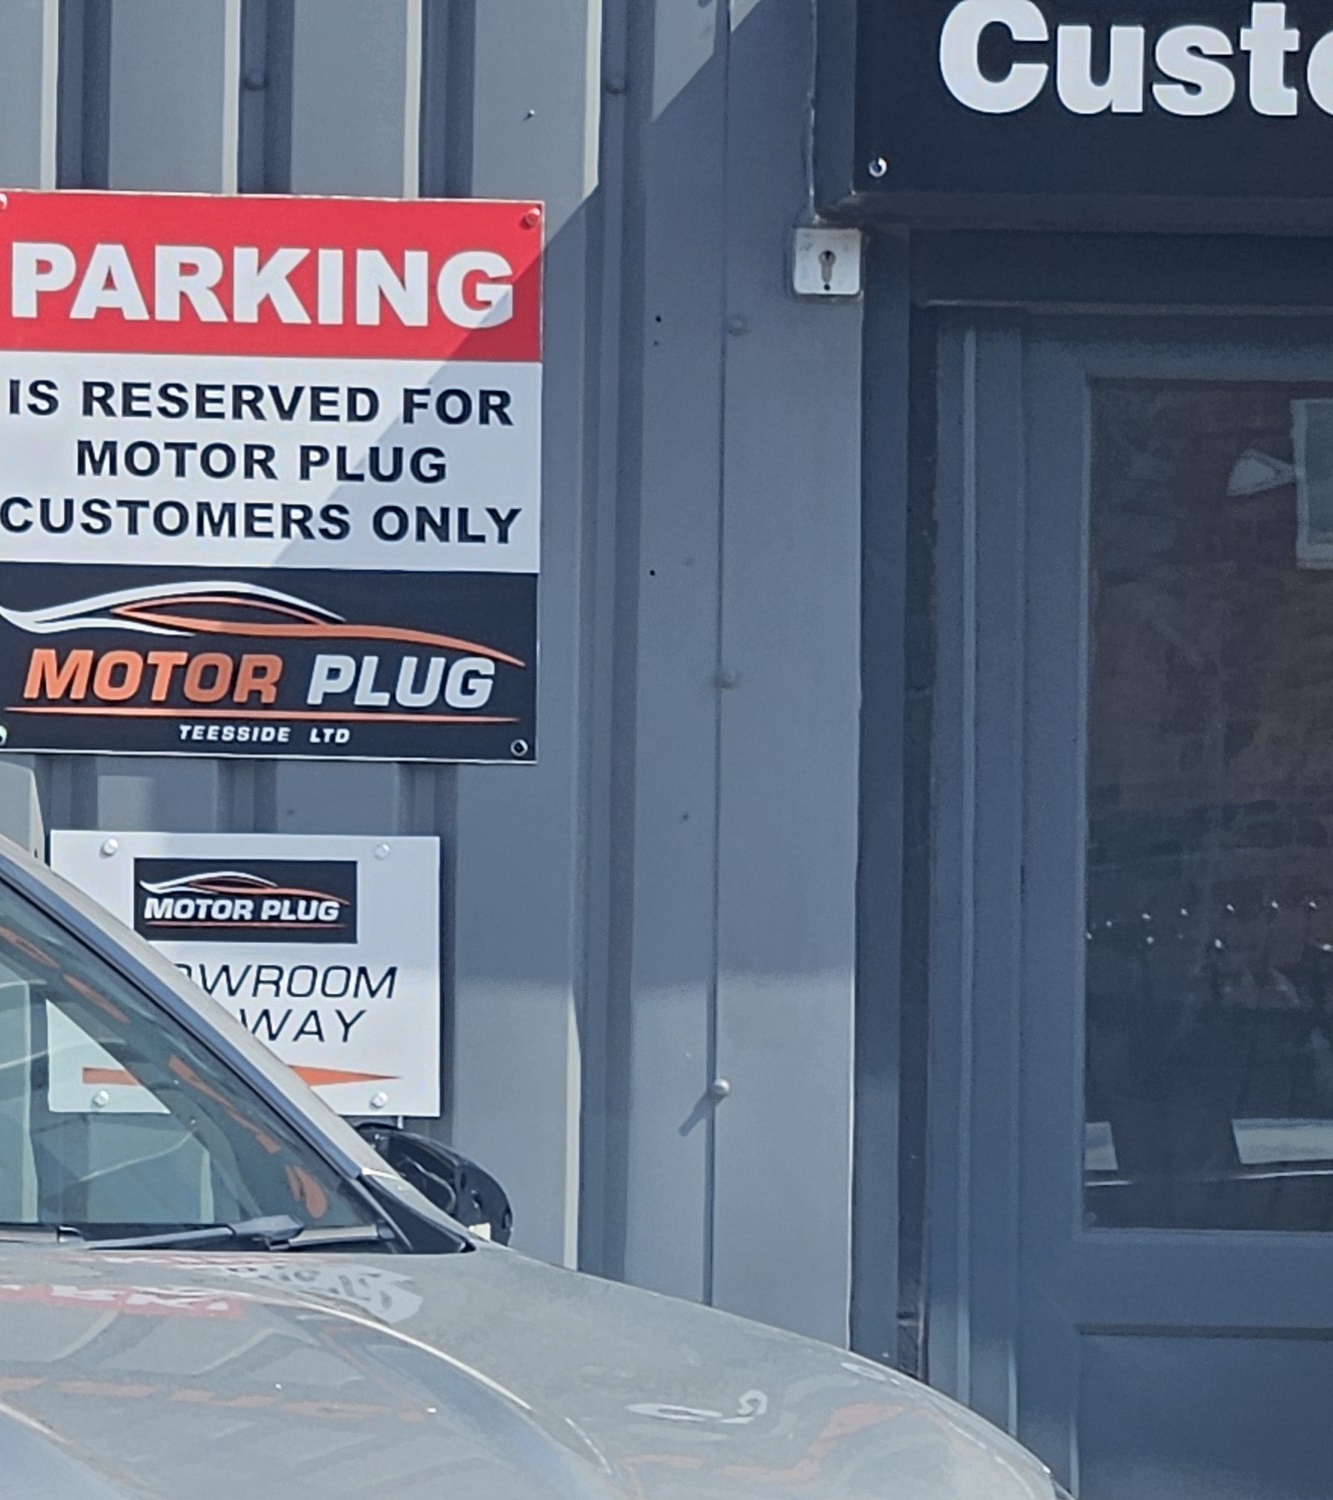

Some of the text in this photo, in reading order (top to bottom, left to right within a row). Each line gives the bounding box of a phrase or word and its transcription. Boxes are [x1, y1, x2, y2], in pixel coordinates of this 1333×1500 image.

[939, 0, 1333, 117] Cust
[10, 241, 514, 328] PARKING
[7, 379, 513, 427] IS RESERVED FOR
[76, 440, 448, 484] MOTOR PLUG
[372, 506, 522, 544] ONLY
[23, 648, 496, 708] MOTOR PLUG
[178, 724, 351, 744] TEESSIDE LTD
[143, 897, 341, 922] MOTOR PLUG
[239, 1008, 368, 1043] WAY
